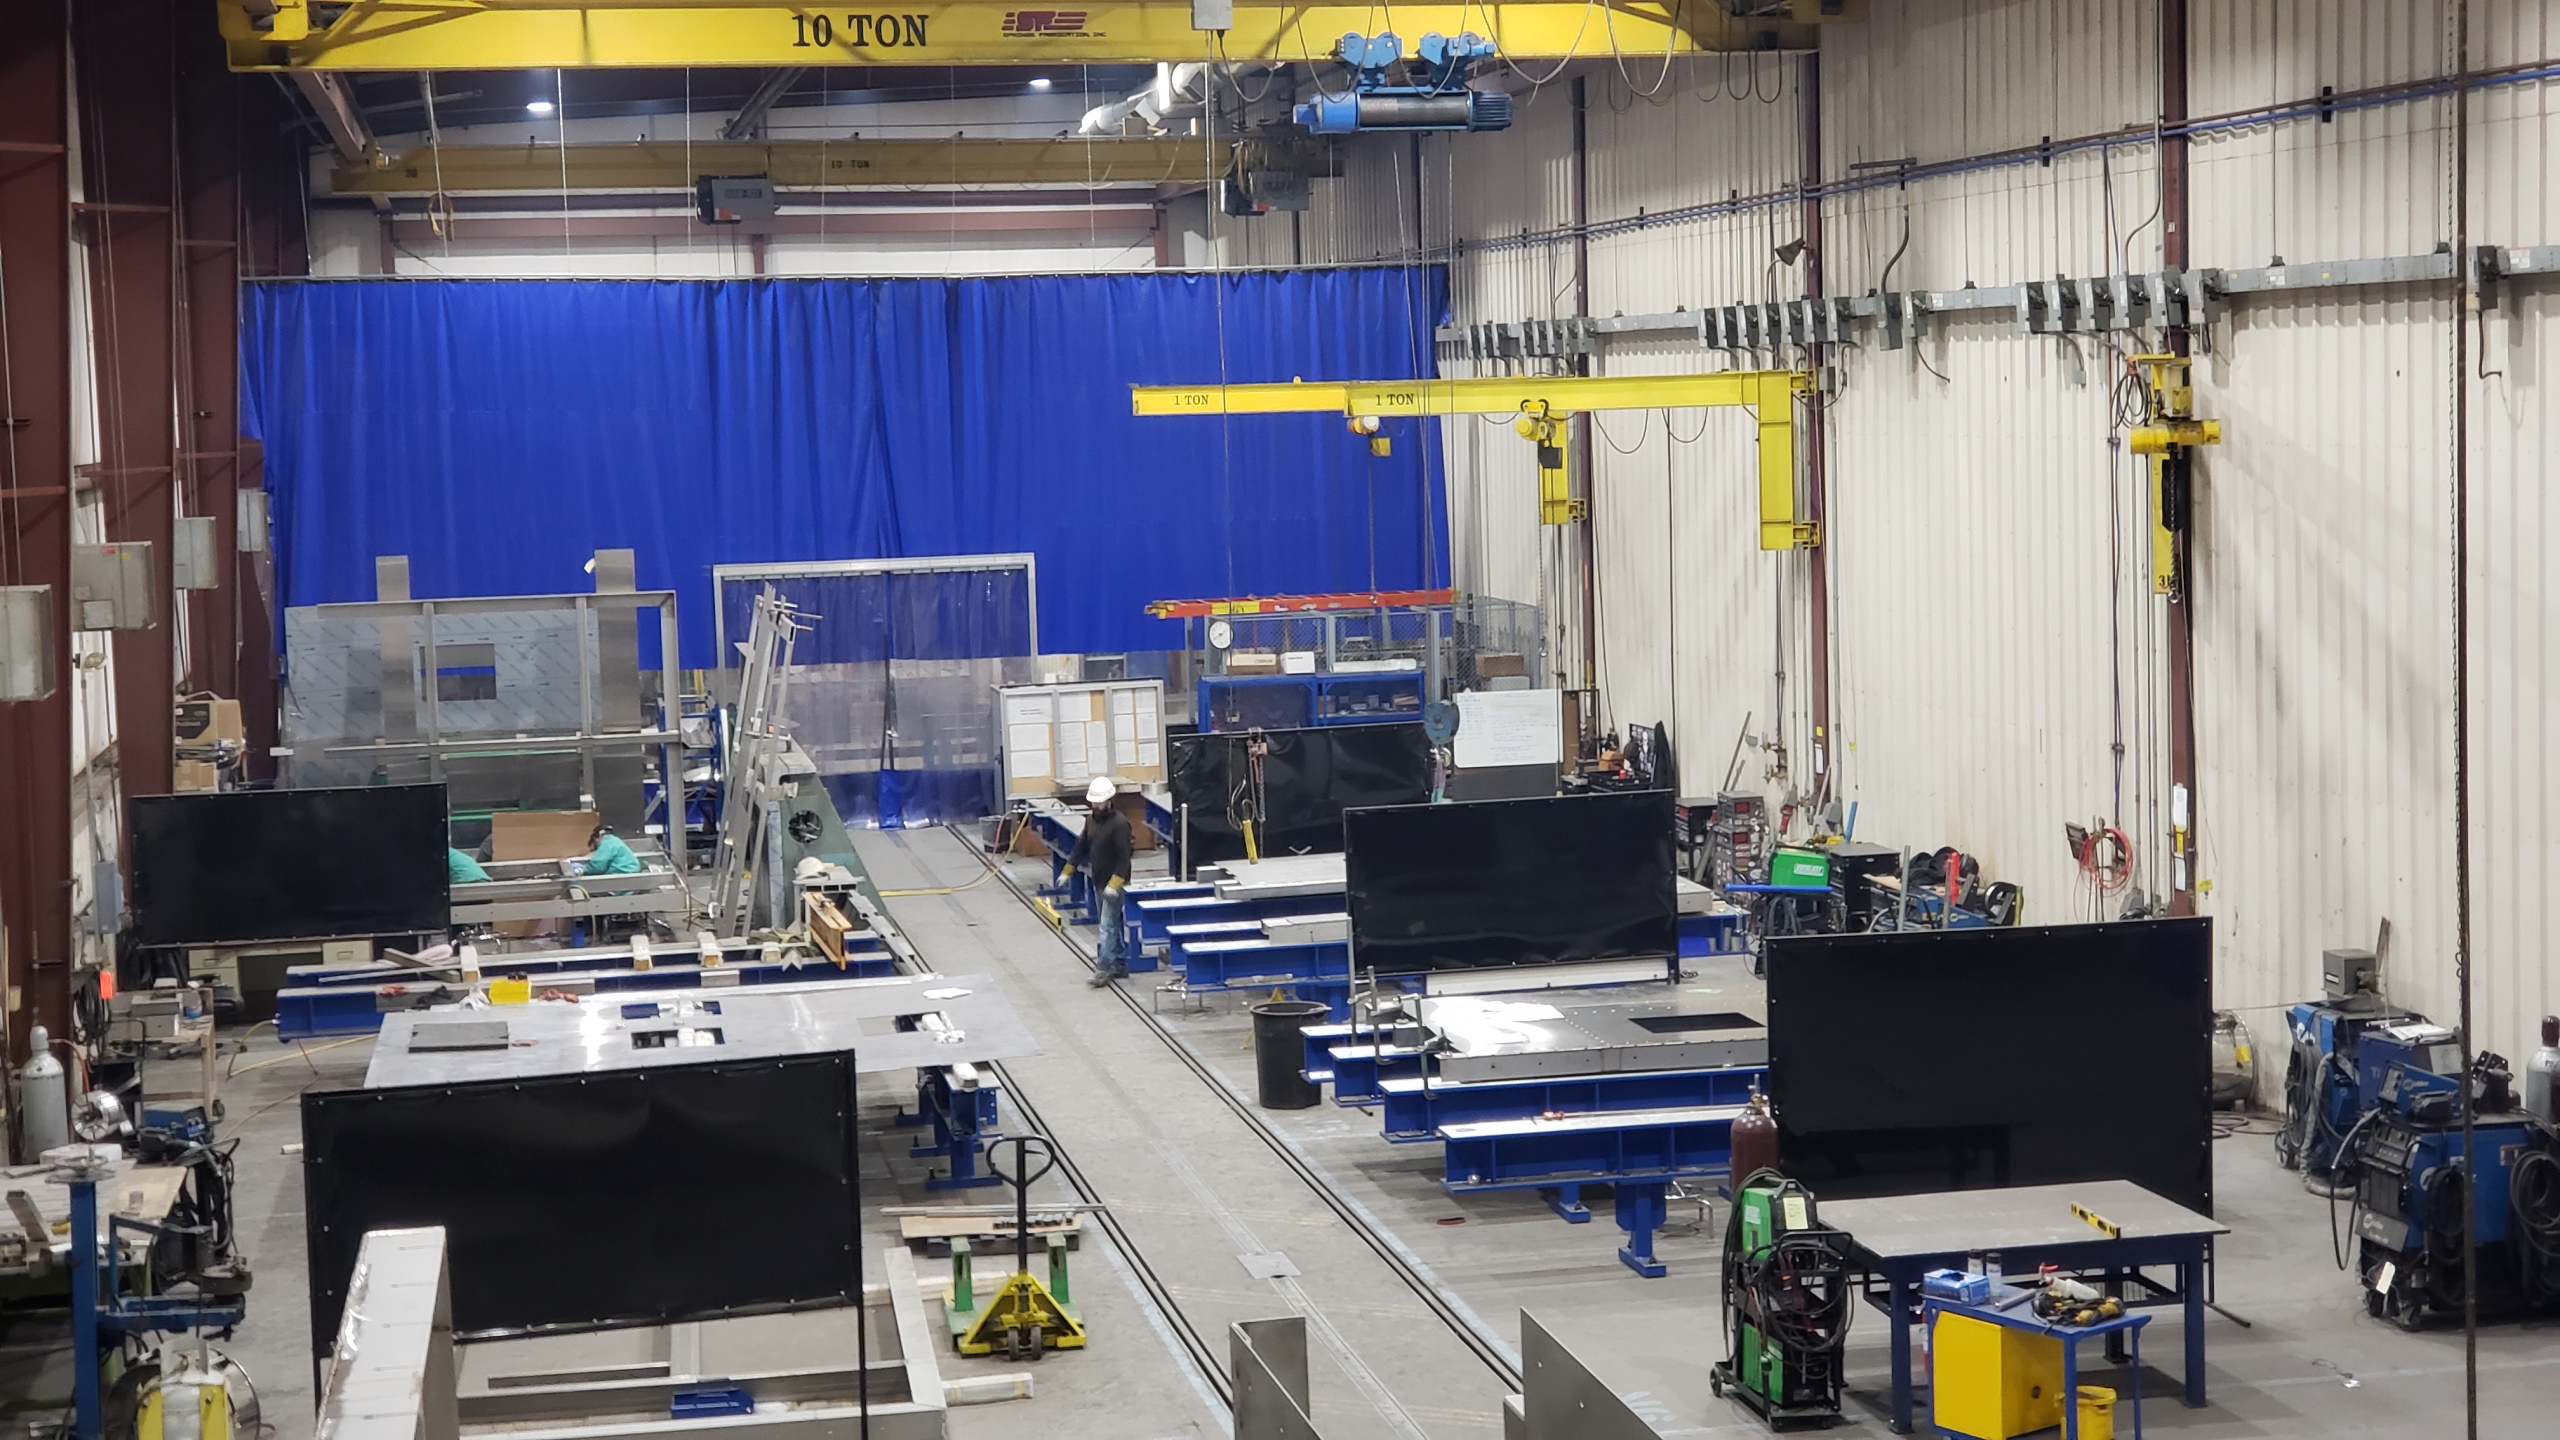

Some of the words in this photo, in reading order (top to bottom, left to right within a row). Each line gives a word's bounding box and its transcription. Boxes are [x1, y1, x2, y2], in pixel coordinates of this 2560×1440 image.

[791, 14, 832, 47] 10
[847, 14, 929, 47] TON
[851, 160, 869, 169] TON
[1174, 395, 1181, 405] 1
[1184, 394, 1209, 405] TON
[1375, 394, 1382, 406] 1
[1386, 393, 1414, 406] TON
